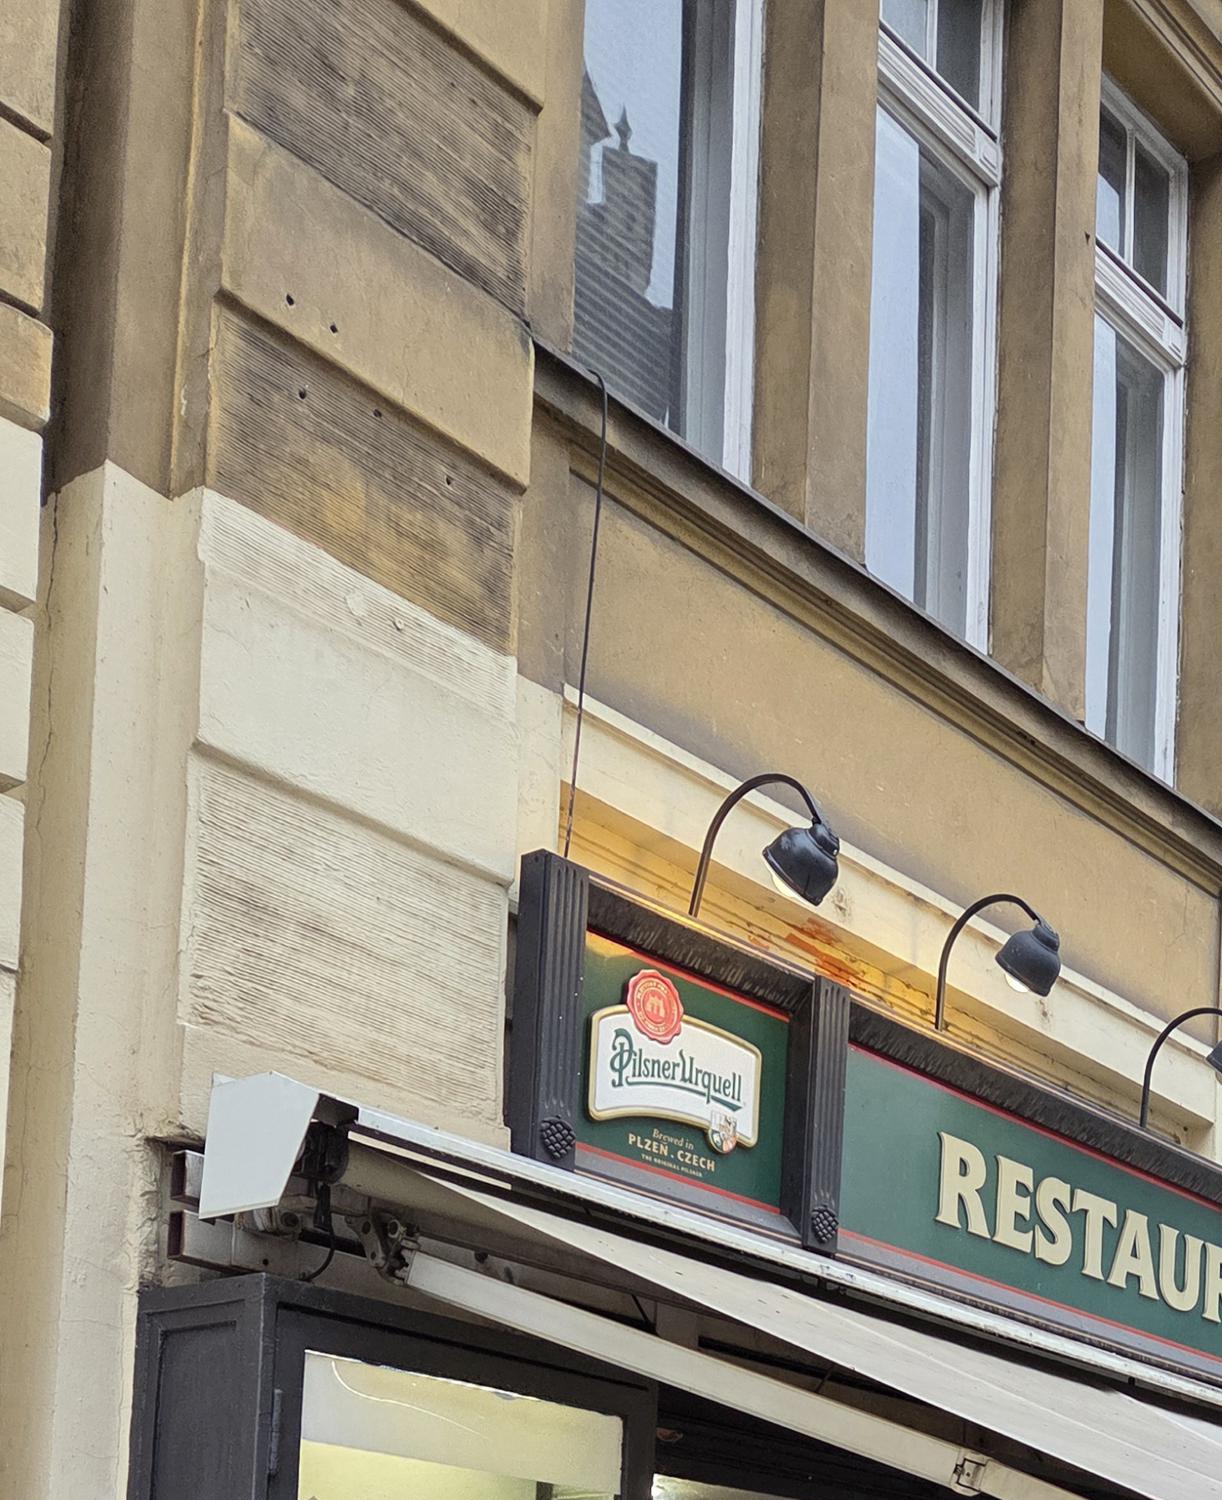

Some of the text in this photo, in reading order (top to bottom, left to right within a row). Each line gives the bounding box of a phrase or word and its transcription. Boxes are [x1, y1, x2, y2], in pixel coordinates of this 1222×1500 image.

[610, 1027, 742, 1105] Pilsner Urquell
[652, 1128, 695, 1151] Brewed in
[677, 1150, 716, 1172] CZECH
